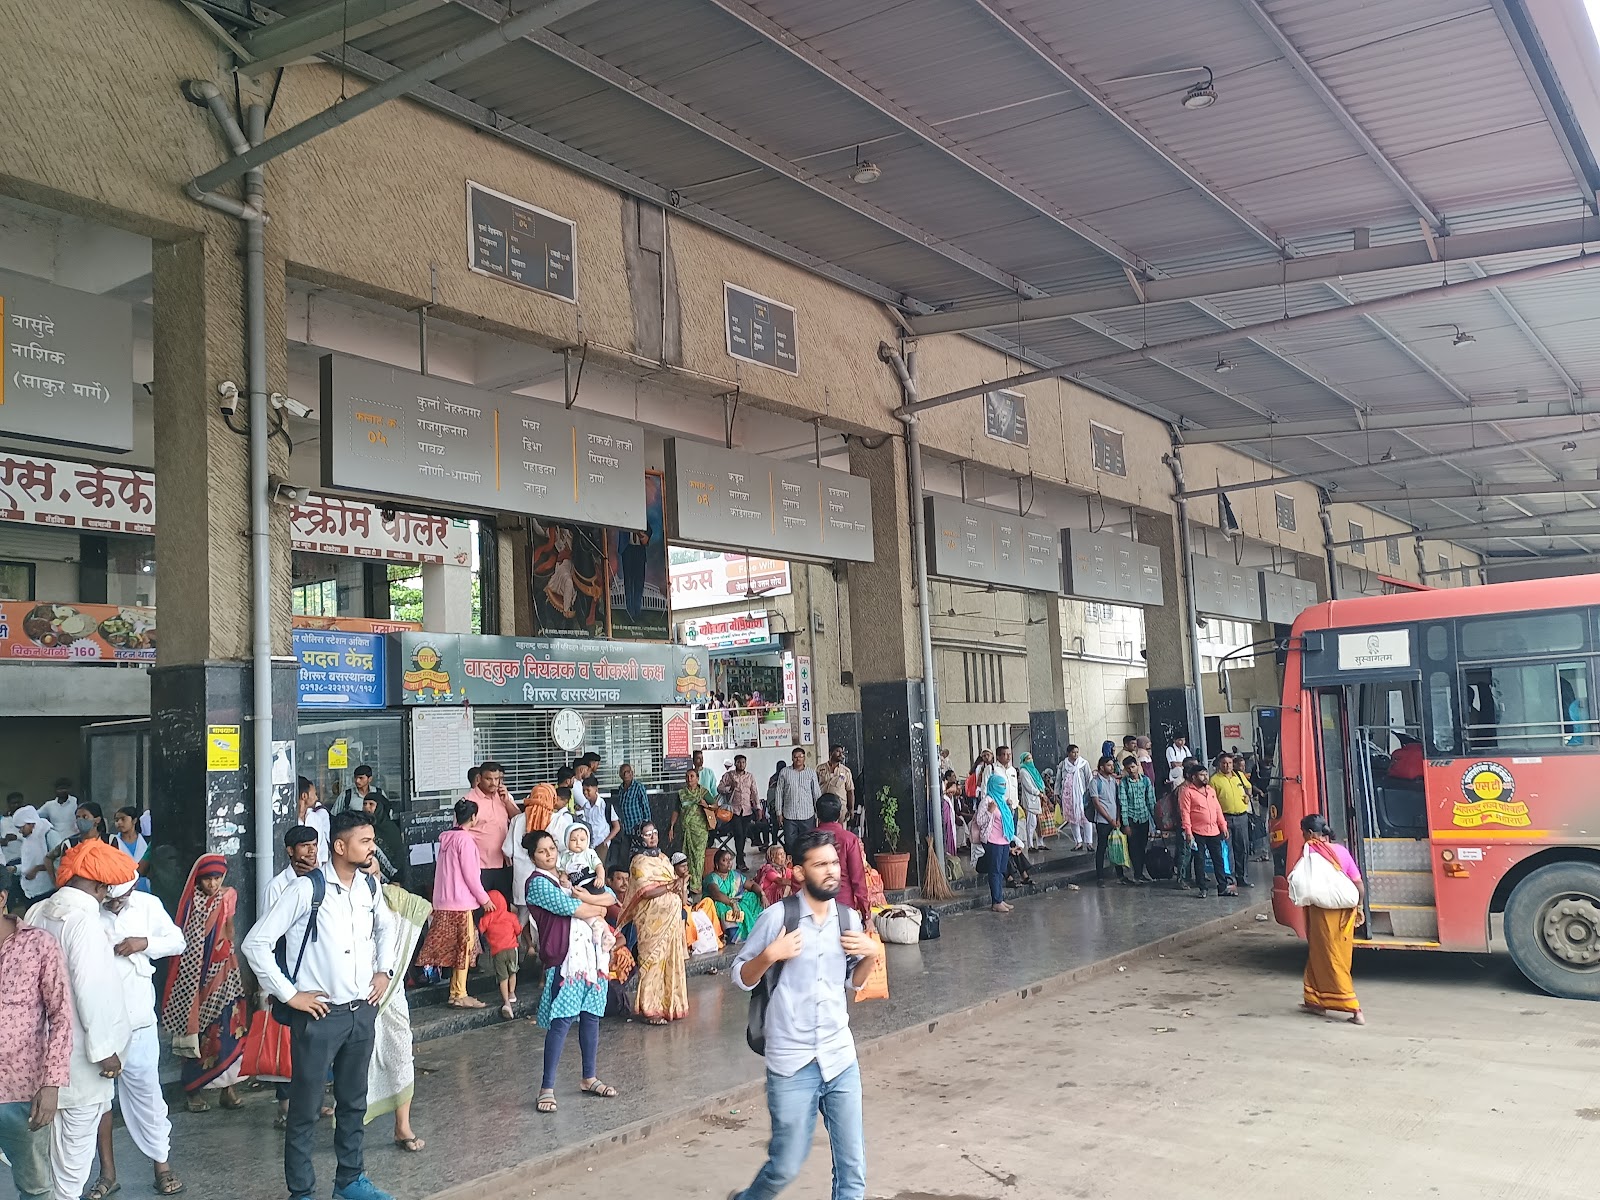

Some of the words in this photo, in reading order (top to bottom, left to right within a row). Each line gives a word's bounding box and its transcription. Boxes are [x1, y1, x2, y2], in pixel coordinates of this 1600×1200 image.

[10, 314, 54, 338] वासुंदे
[10, 342, 66, 364] नाशिक
[14, 371, 66, 397] (साकुर
[72, 381, 110, 403] मार्गे)
[416, 396, 440, 412] कुर्ला
[522, 416, 540, 432] मंचर
[587, 434, 613, 448] टाकळी
[616, 440, 633, 452] हाजी
[418, 462, 481, 483] लोणी-धामणी
[522, 461, 556, 476] पहाडदरा
[588, 472, 604, 484] ठाणे
[300, 633, 324, 644] पोलिस
[326, 635, 346, 646] स्टेशन
[348, 636, 370, 646] अंकित
[516, 642, 536, 650] महाराष्ट्र
[537, 642, 549, 650] राज्य
[11, 644, 41, 656] चिकन
[302, 650, 340, 668] मदत
[344, 648, 374, 670] केंद्र
[328, 672, 376, 682] बसस्थानक
[464, 658, 520, 686] वाहतुक
[524, 653, 575, 680] नियंत्रक
[578, 662, 590, 680] व
[593, 656, 638, 681] चौकशी
[641, 664, 666, 682] कक्ष
[523, 683, 558, 702] शिरूर
[560, 688, 620, 702] बसस्थानक
